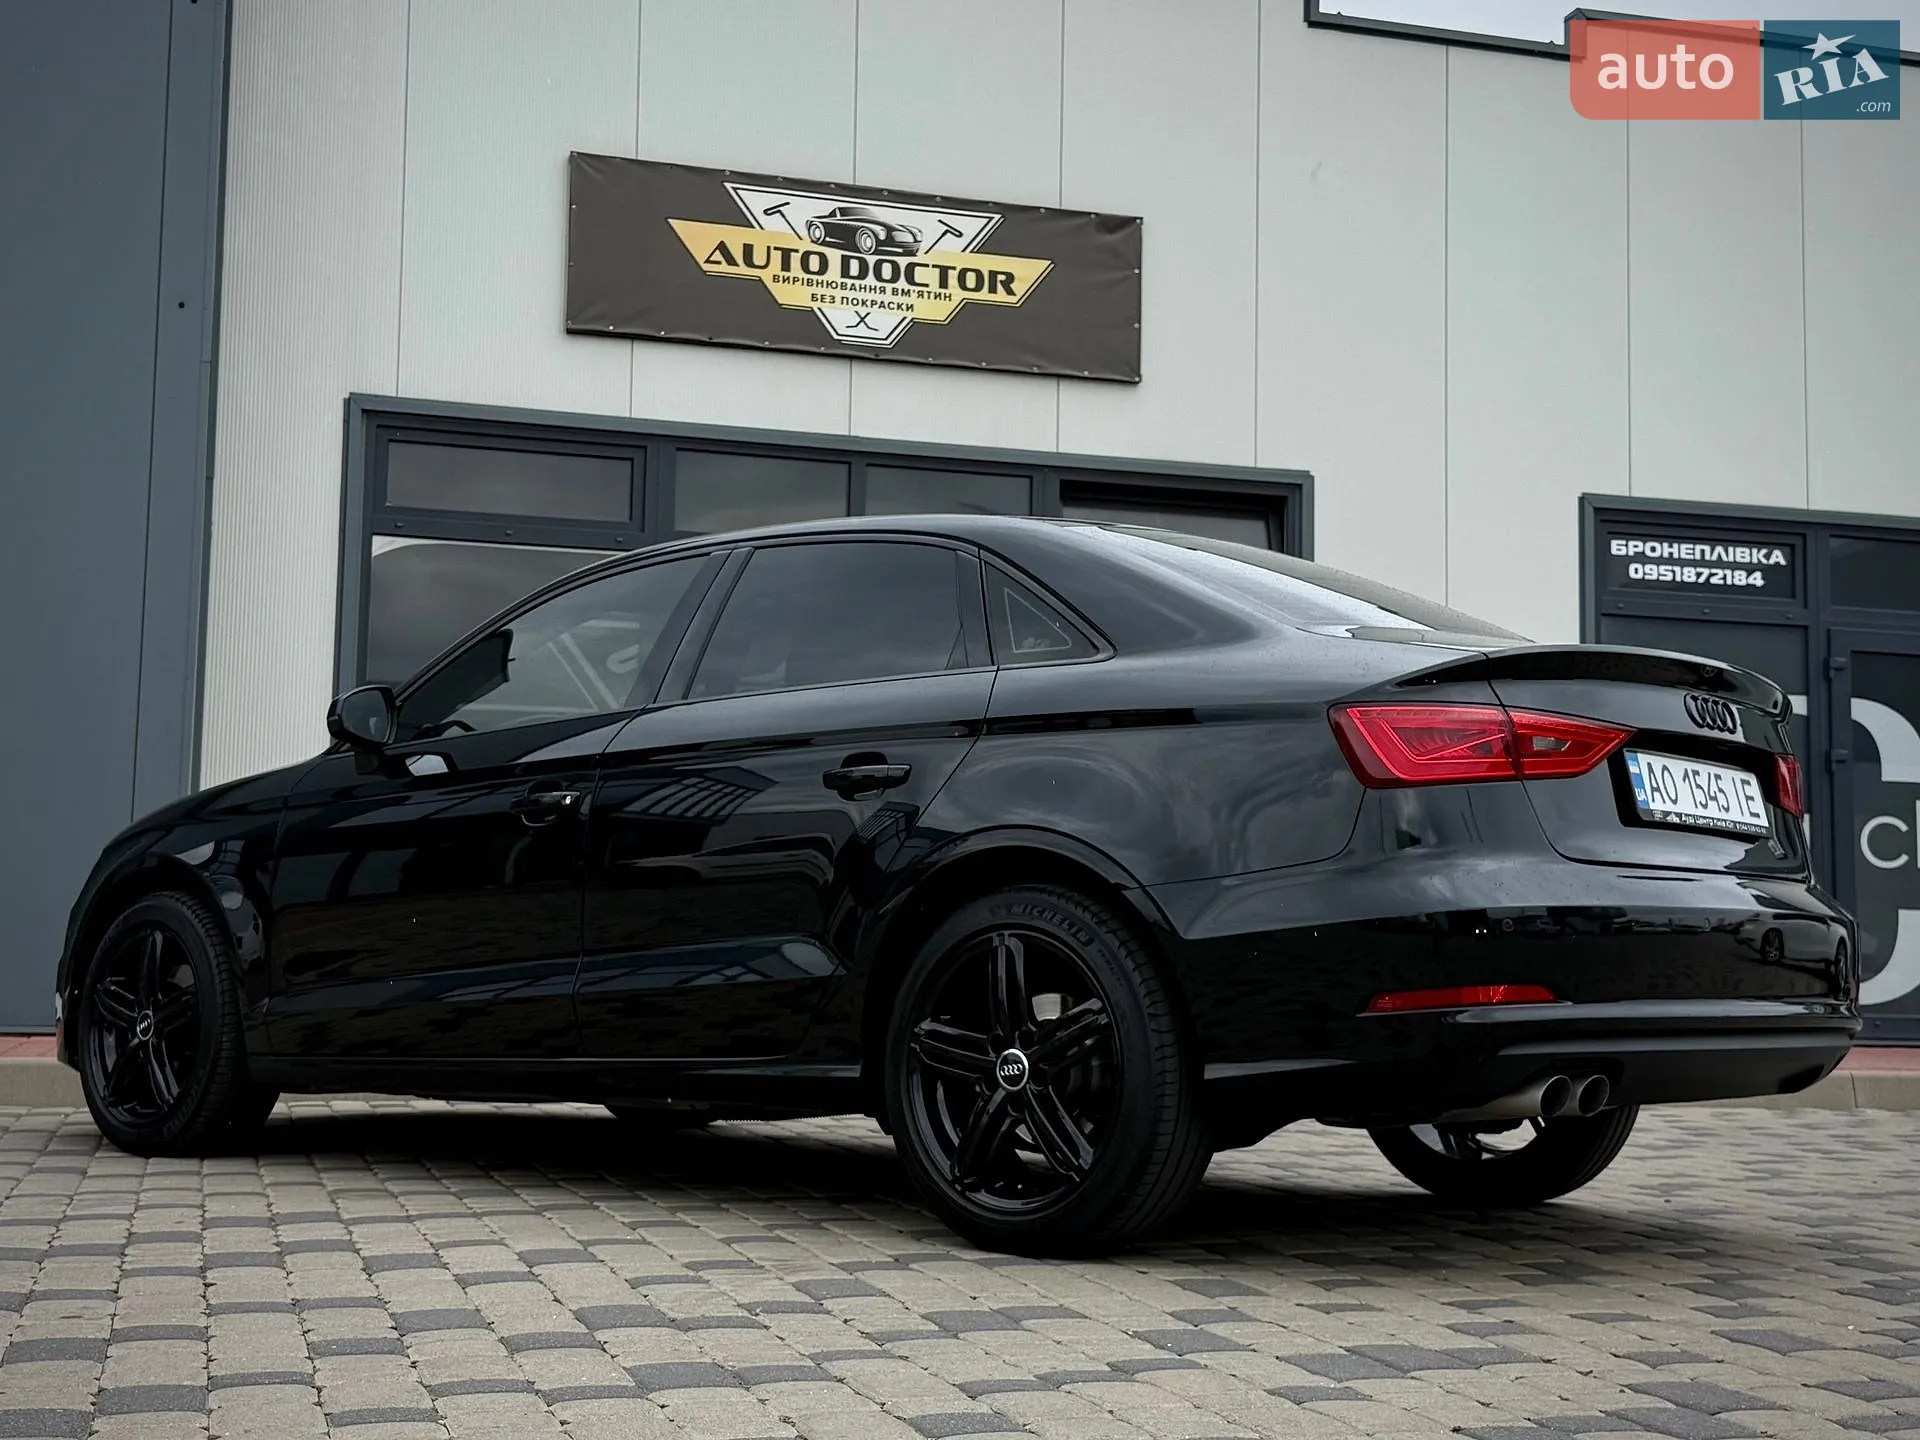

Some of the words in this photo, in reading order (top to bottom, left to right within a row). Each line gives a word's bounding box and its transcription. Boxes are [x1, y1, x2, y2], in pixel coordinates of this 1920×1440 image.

[703, 239, 830, 276] AUTO
[840, 253, 1018, 297] DOCTOR
[771, 273, 887, 296] ВИРІВНЮВАННЯ
[810, 292, 837, 305] БЕЗ
[840, 295, 915, 313] ПОКРАСКИ
[1609, 538, 1788, 566] БРОНЕПЛІВКА
[1628, 562, 1765, 588] 0951872184
[1646, 761, 1679, 806] AO
[1682, 767, 1731, 814] 1545
[1730, 776, 1761, 820] IE
[1010, 903, 1091, 944] MICHELIN
